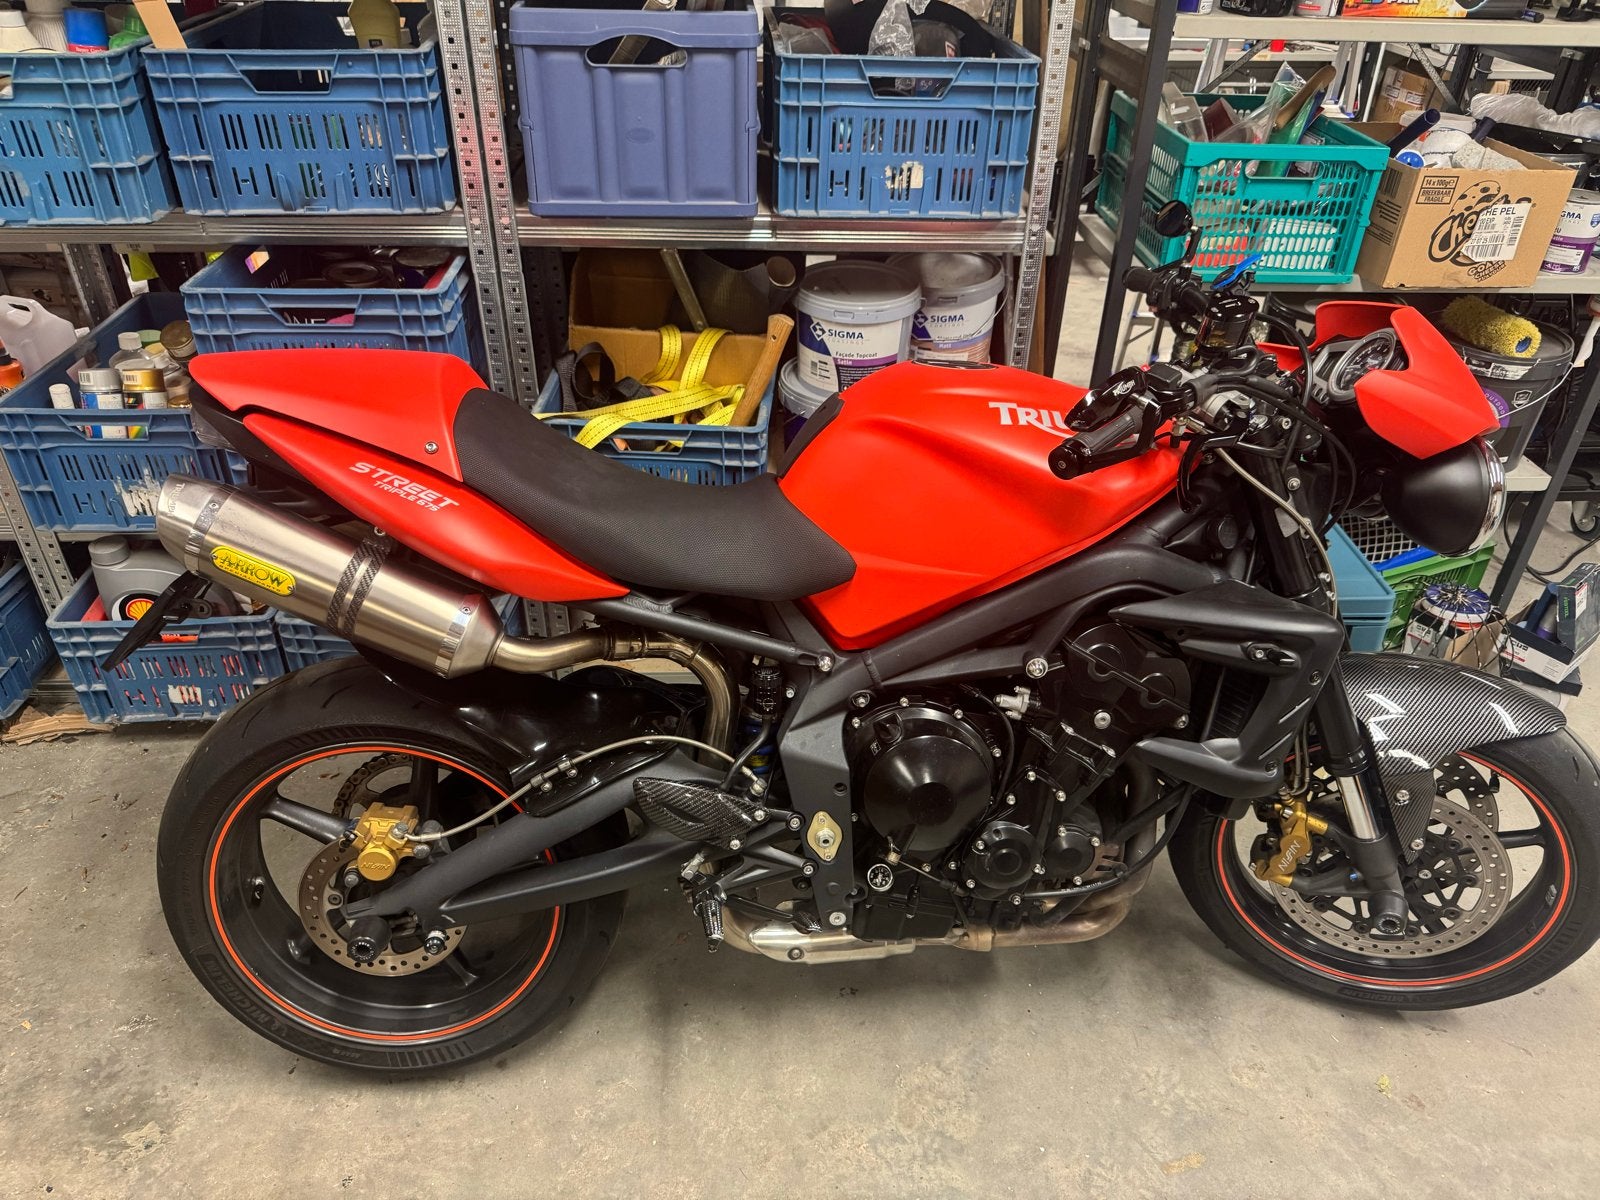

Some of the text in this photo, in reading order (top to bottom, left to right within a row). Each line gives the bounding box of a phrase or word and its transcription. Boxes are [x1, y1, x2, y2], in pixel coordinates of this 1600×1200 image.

[1481, 207, 1516, 217] HE PEL
[1560, 211, 1581, 220] GMA
[929, 314, 964, 323] SIGMA
[828, 328, 864, 340] SIGMA
[1484, 393, 1505, 415] OUTDOO
[988, 402, 1072, 439] TRIU
[349, 462, 460, 507] STREET
[373, 481, 440, 512] TRIPLE 675
[219, 554, 288, 588] ARROW
